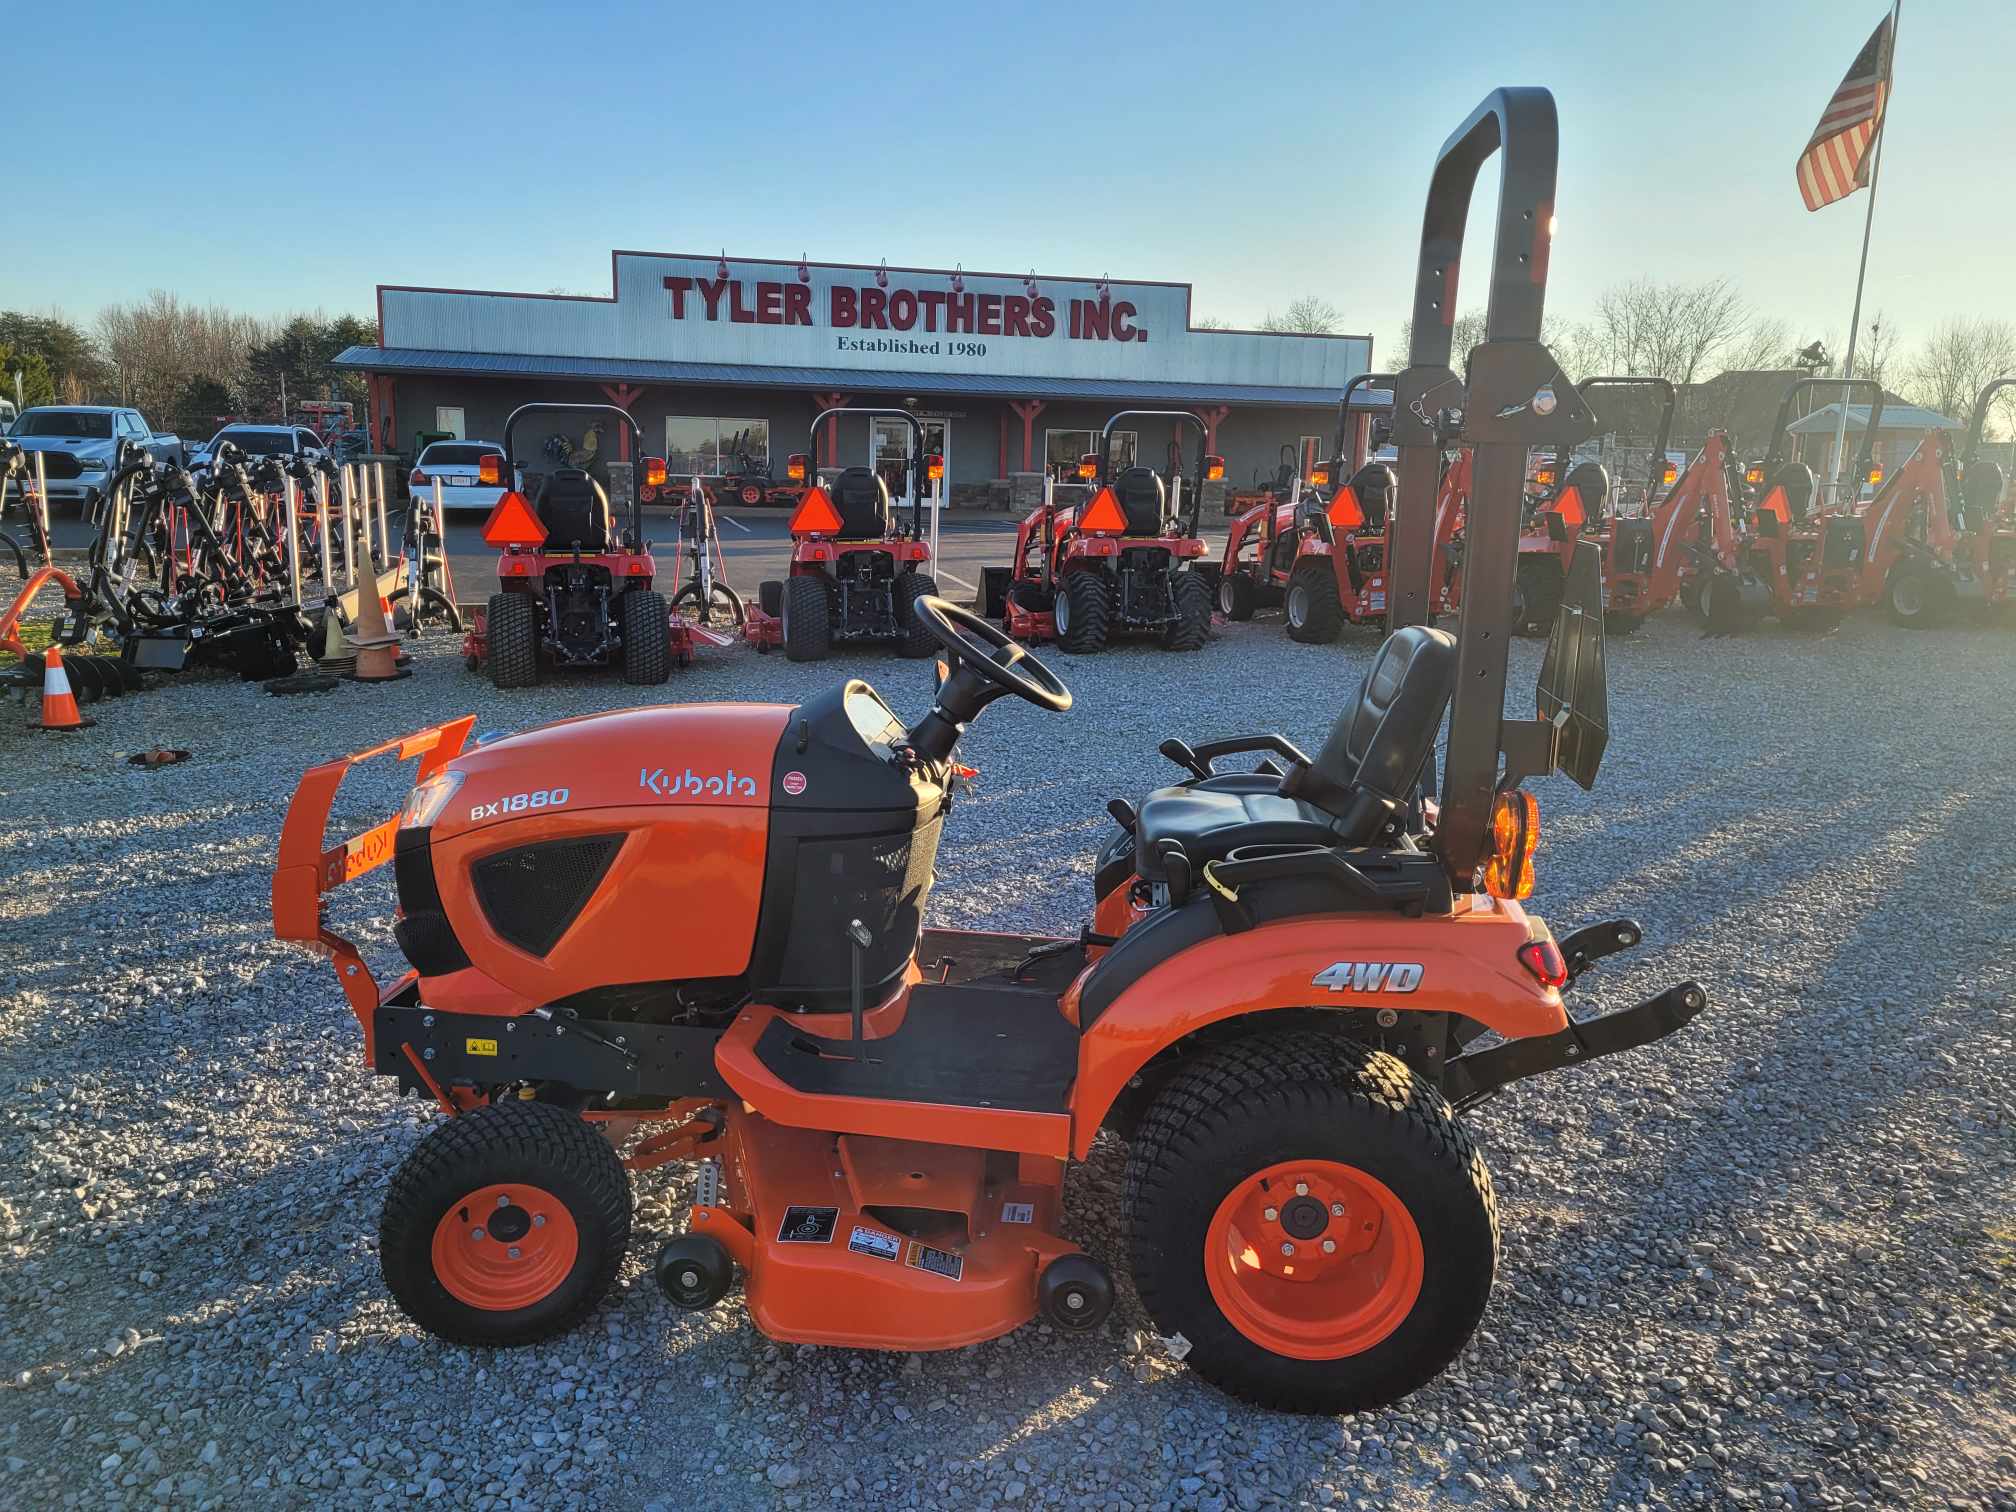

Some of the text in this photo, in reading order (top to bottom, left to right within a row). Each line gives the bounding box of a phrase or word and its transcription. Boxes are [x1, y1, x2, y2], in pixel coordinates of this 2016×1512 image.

[664, 276, 1148, 343] TYLER BROTHERS INC.
[837, 335, 987, 358] Established 1980
[639, 768, 757, 797] Kubota
[470, 788, 569, 821] BX1880
[1311, 961, 1425, 993] 4WD
